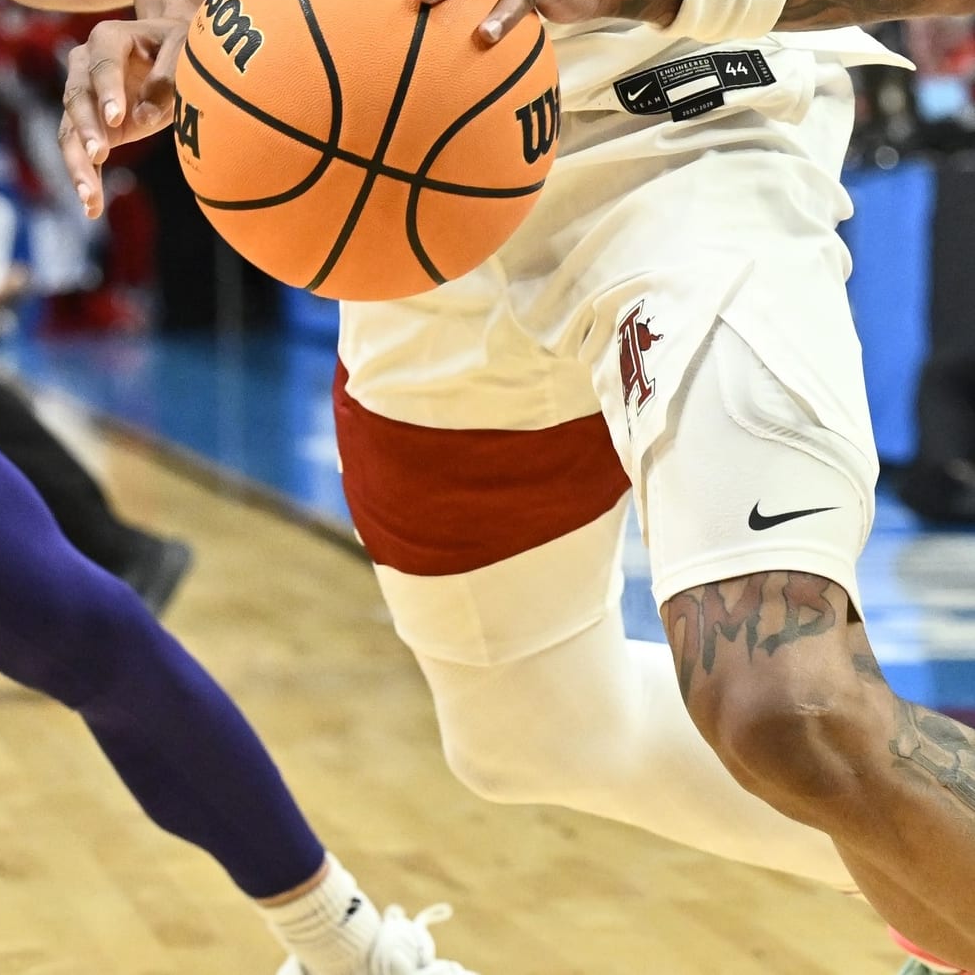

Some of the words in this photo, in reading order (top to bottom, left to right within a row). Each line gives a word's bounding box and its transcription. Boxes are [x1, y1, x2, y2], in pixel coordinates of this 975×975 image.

[659, 58, 710, 77] ENGINEERED
[725, 61, 749, 77] 44
[632, 95, 661, 110] TEAM
